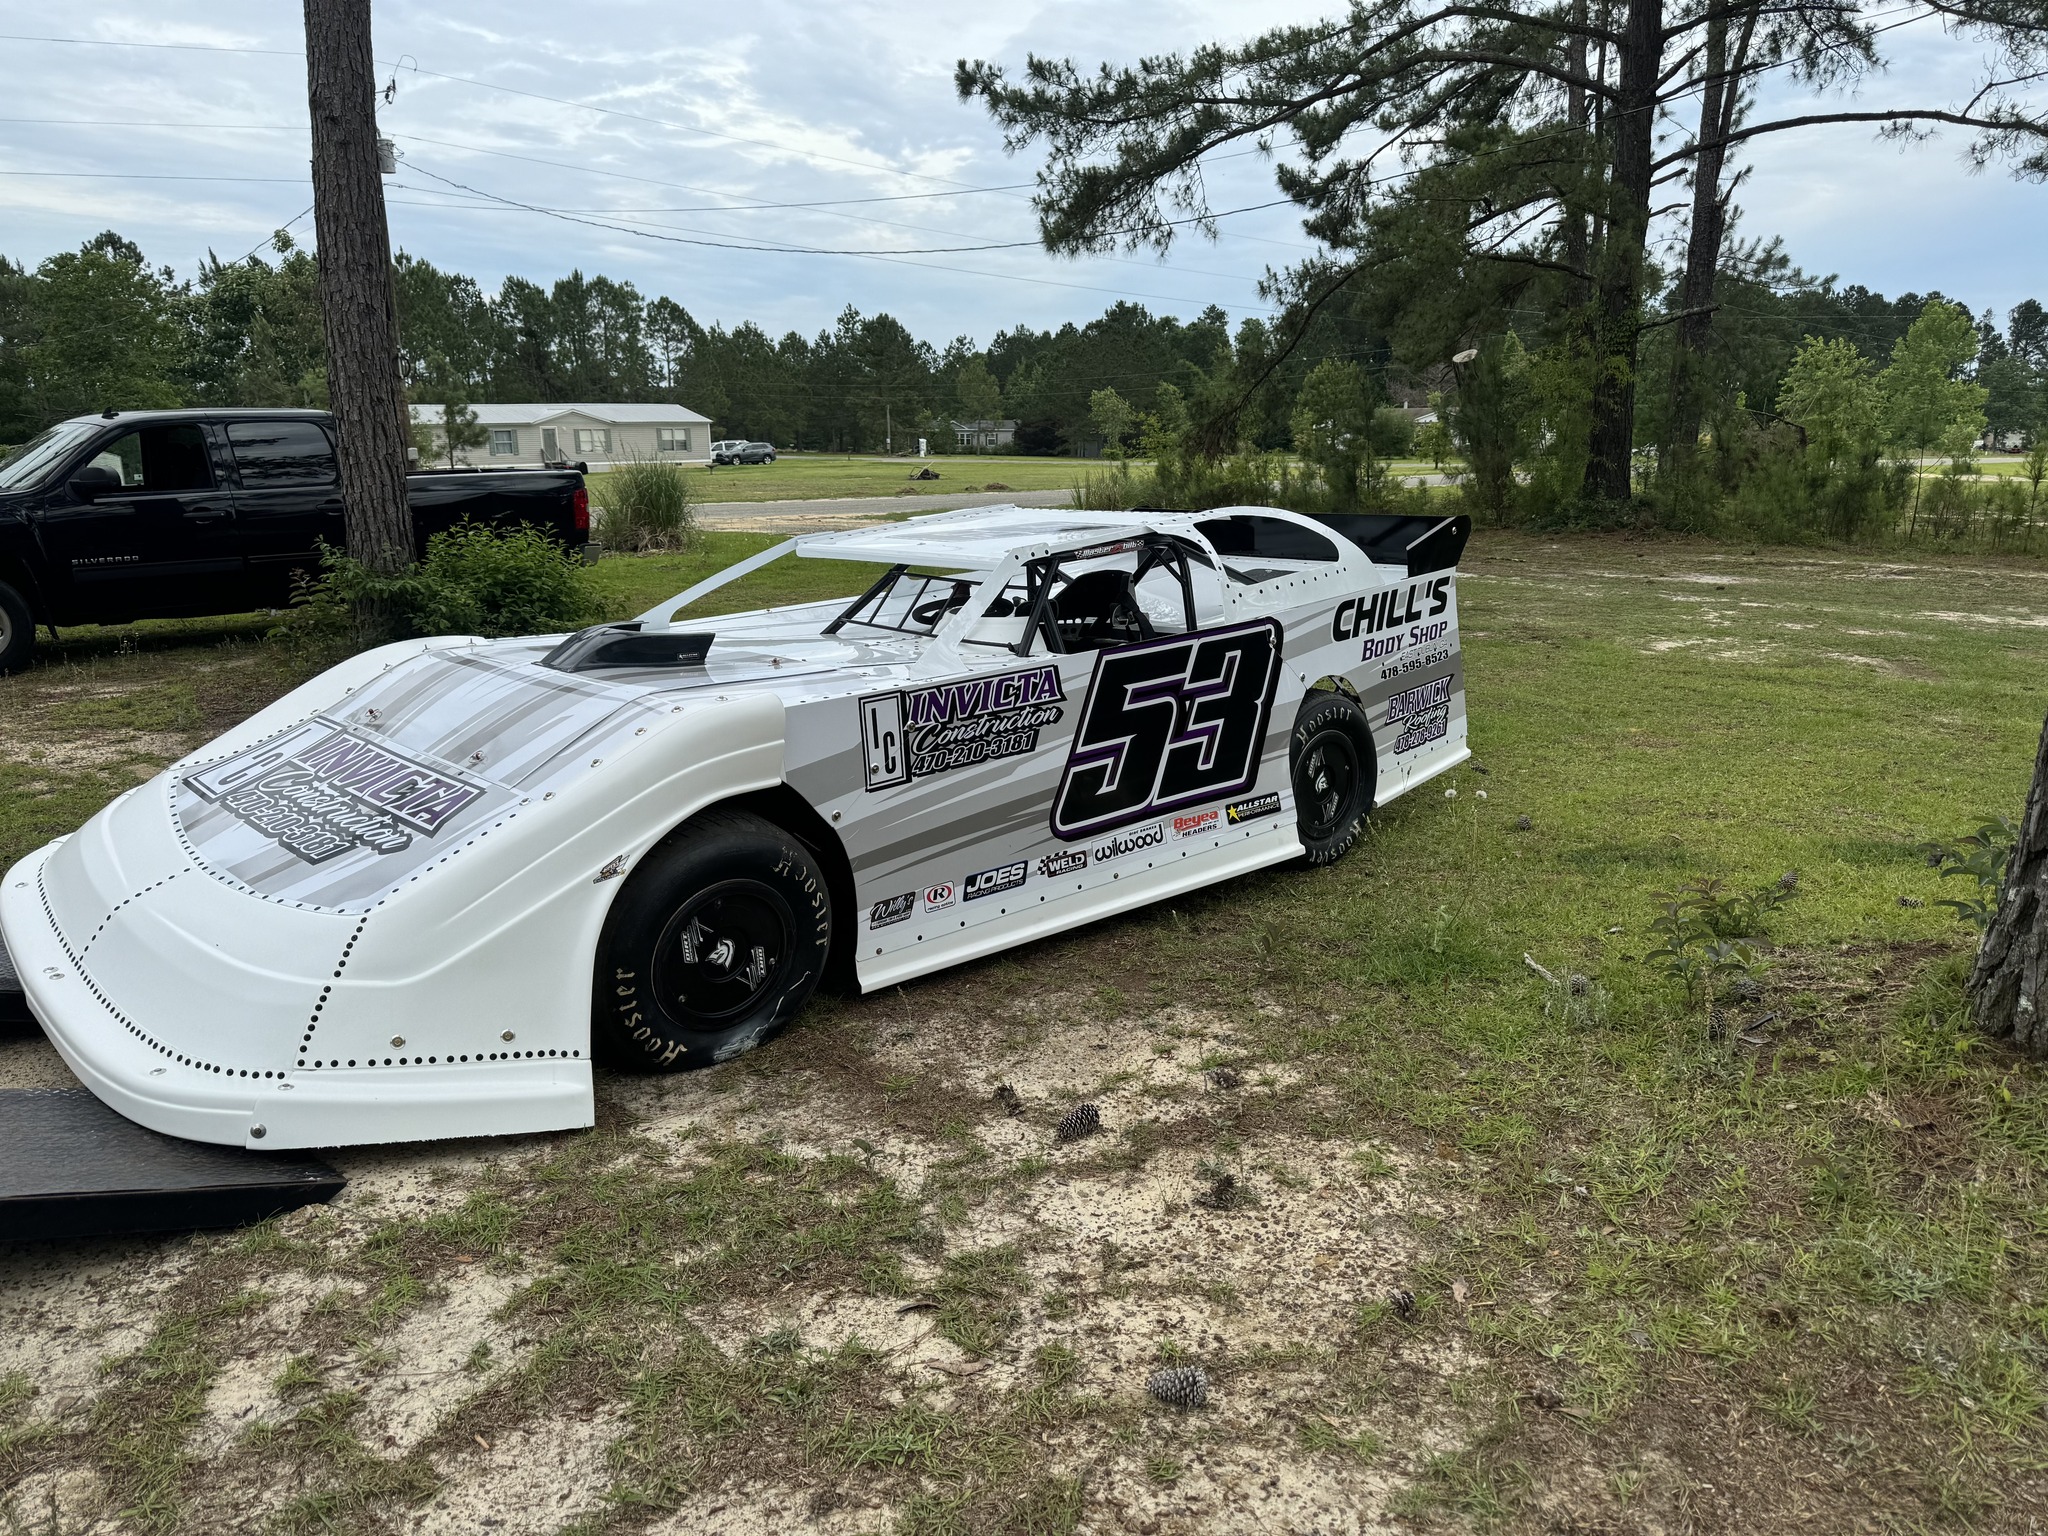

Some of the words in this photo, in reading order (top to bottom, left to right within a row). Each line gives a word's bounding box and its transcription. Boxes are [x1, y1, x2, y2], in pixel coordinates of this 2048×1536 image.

[72, 556, 139, 566] SILVERADO
[1333, 575, 1451, 642] CHILL'S
[1380, 649, 1449, 680] 478-595-8523
[906, 666, 1062, 728] INVICTA
[1387, 676, 1451, 723] BARWICK
[911, 705, 1059, 756] Construction
[1053, 621, 1278, 836] 53
[1403, 704, 1448, 732] Roofing
[911, 730, 1034, 774] 470-210-3181
[1394, 721, 1446, 752] 478-278-9261
[291, 734, 480, 831] INVICTA
[258, 770, 408, 849] Construction
[1236, 795, 1278, 812] ALLSTAR
[1237, 802, 1280, 818] PERFORMANCE
[225, 789, 351, 860] 470-210-3181
[1173, 810, 1219, 831] Beyea
[1182, 823, 1218, 838] HEADERS
[1094, 823, 1164, 862] wilwood
[966, 862, 1025, 893] JOES
[1048, 854, 1085, 872] WELD
[967, 887, 991, 899] RACING
[991, 878, 1024, 893] PRODUCTS
[870, 894, 914, 920] Willy's
